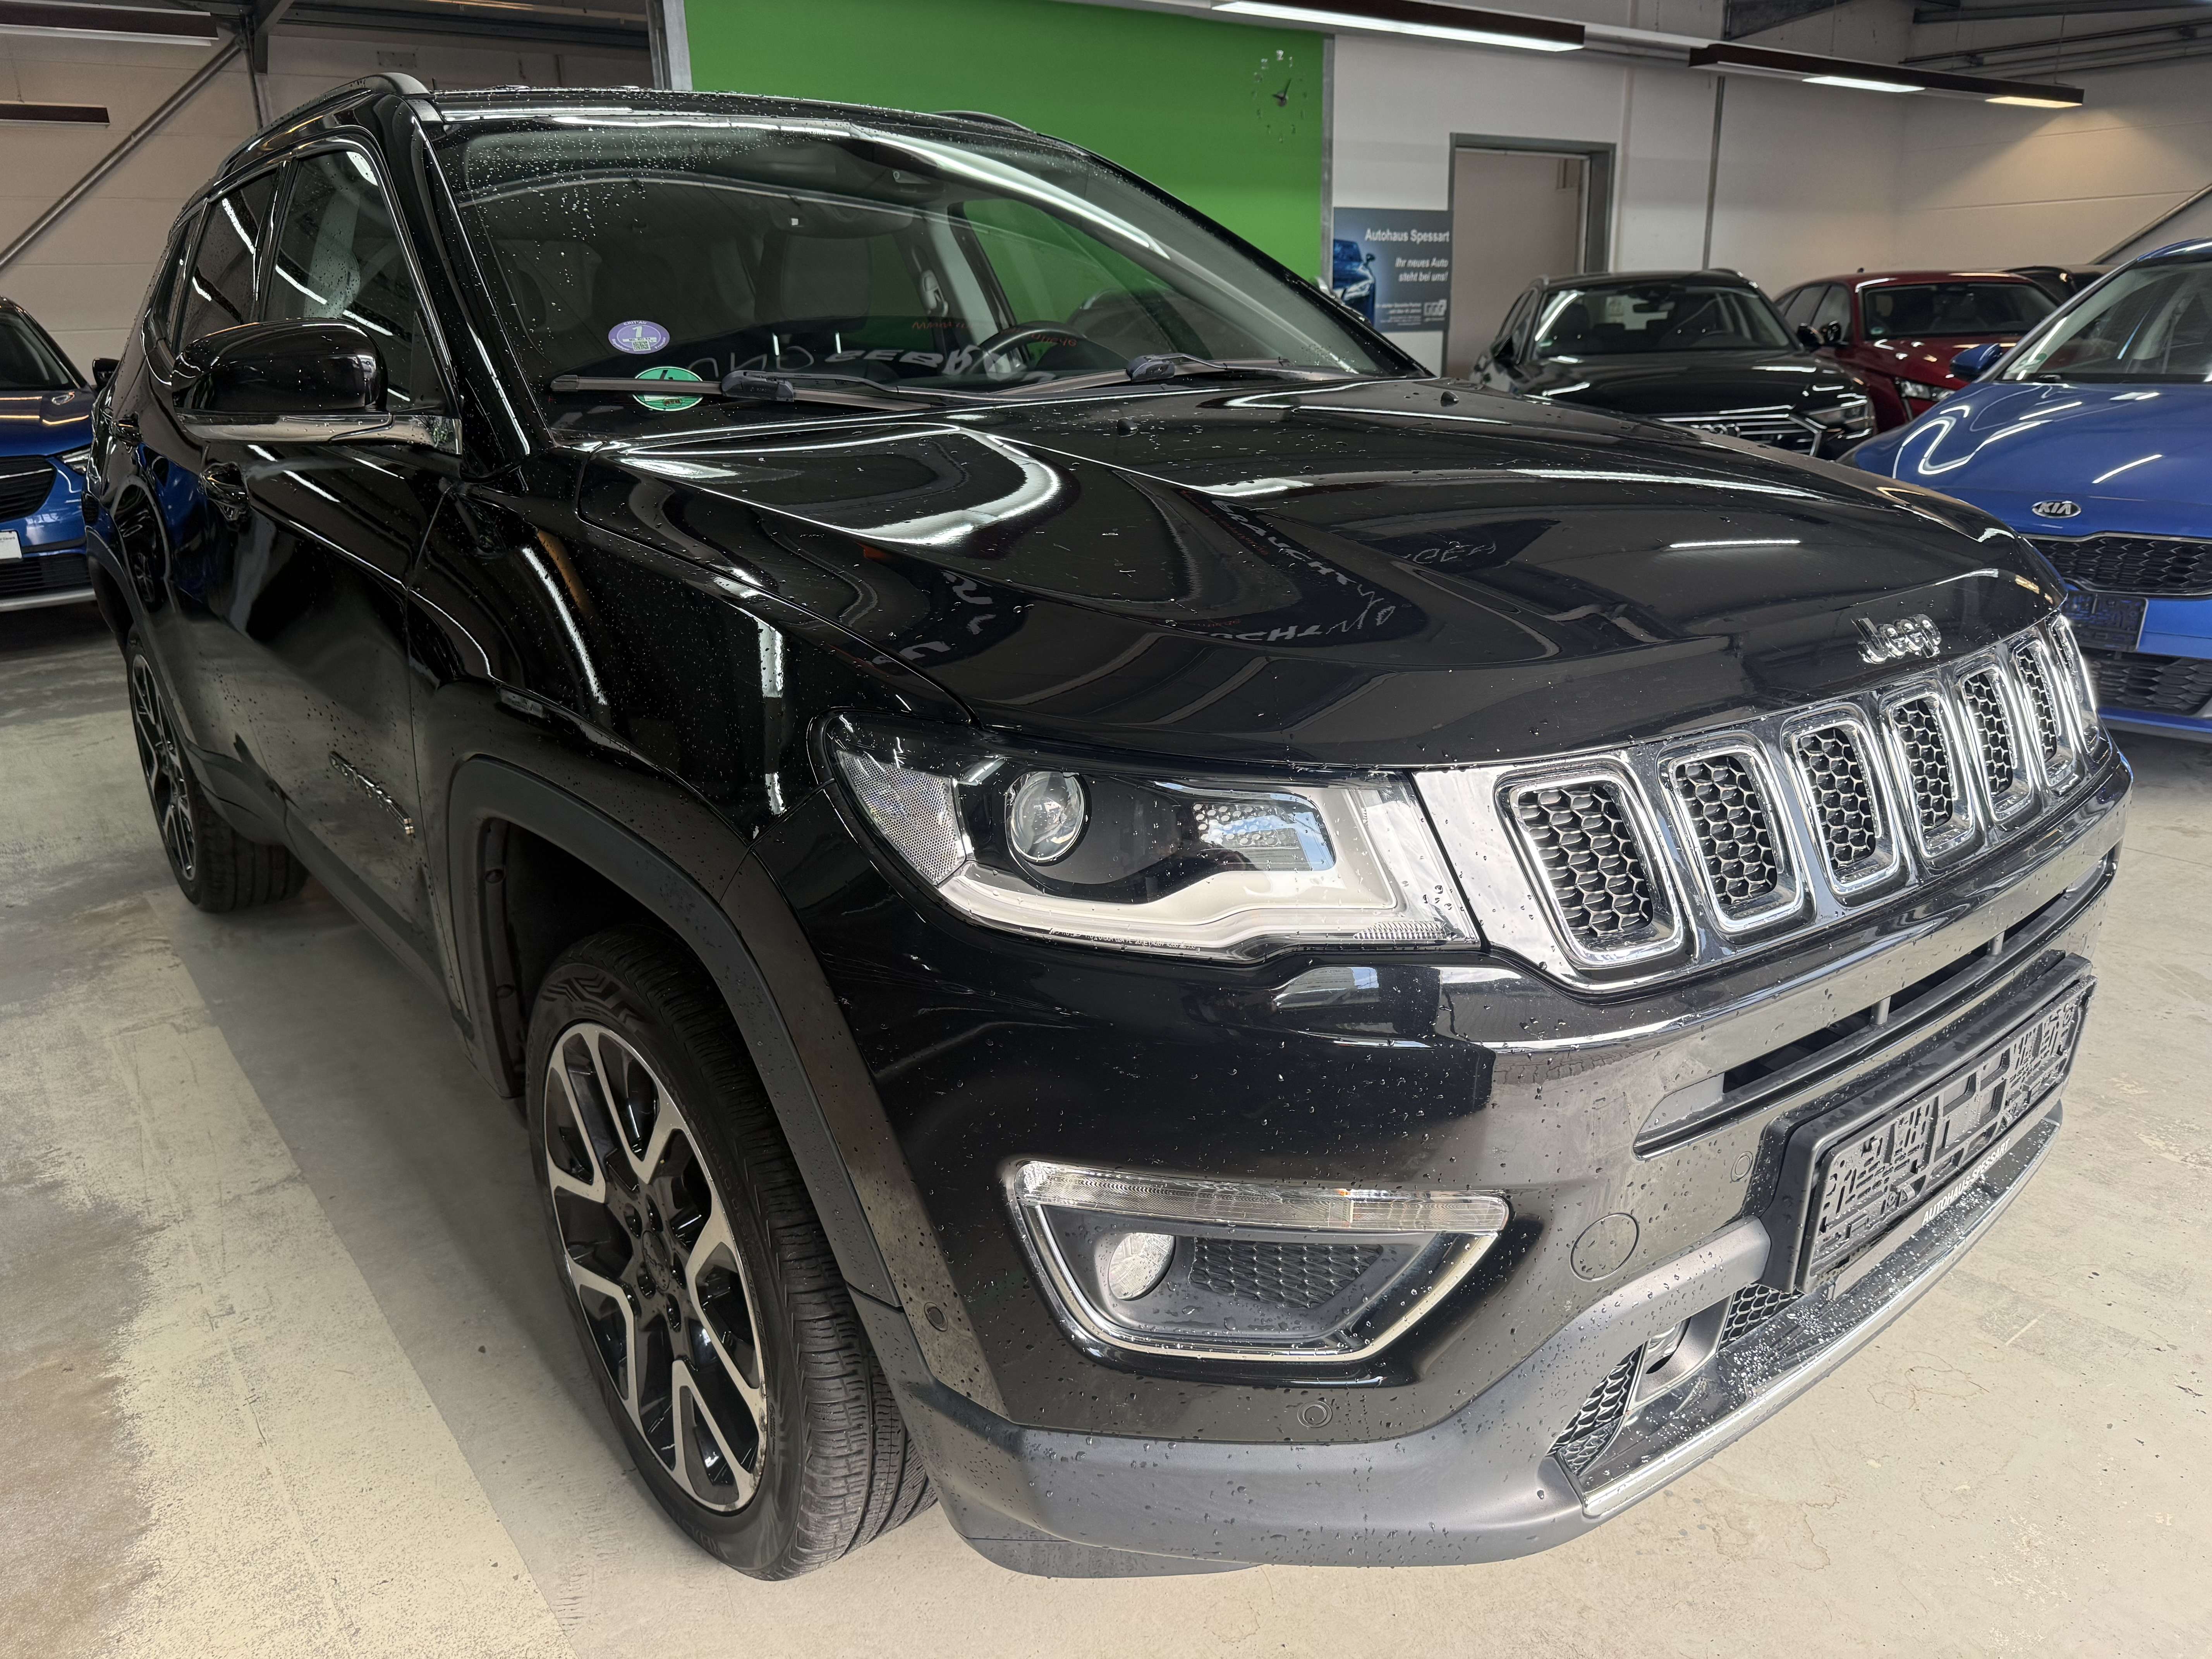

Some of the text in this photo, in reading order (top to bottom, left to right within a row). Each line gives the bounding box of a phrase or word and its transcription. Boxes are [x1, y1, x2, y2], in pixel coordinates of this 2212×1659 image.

[1364, 228, 1450, 244] Autohaus Spessart
[1395, 257, 1449, 268] Ihr neues Auto
[1398, 272, 1449, 282] steht bei uns!
[632, 326, 643, 338] 1
[2038, 502, 2071, 515] KIA
[1850, 613, 1942, 665] Jeep
[1922, 1138, 2011, 1226] AUTOHAUS-SPESSART
